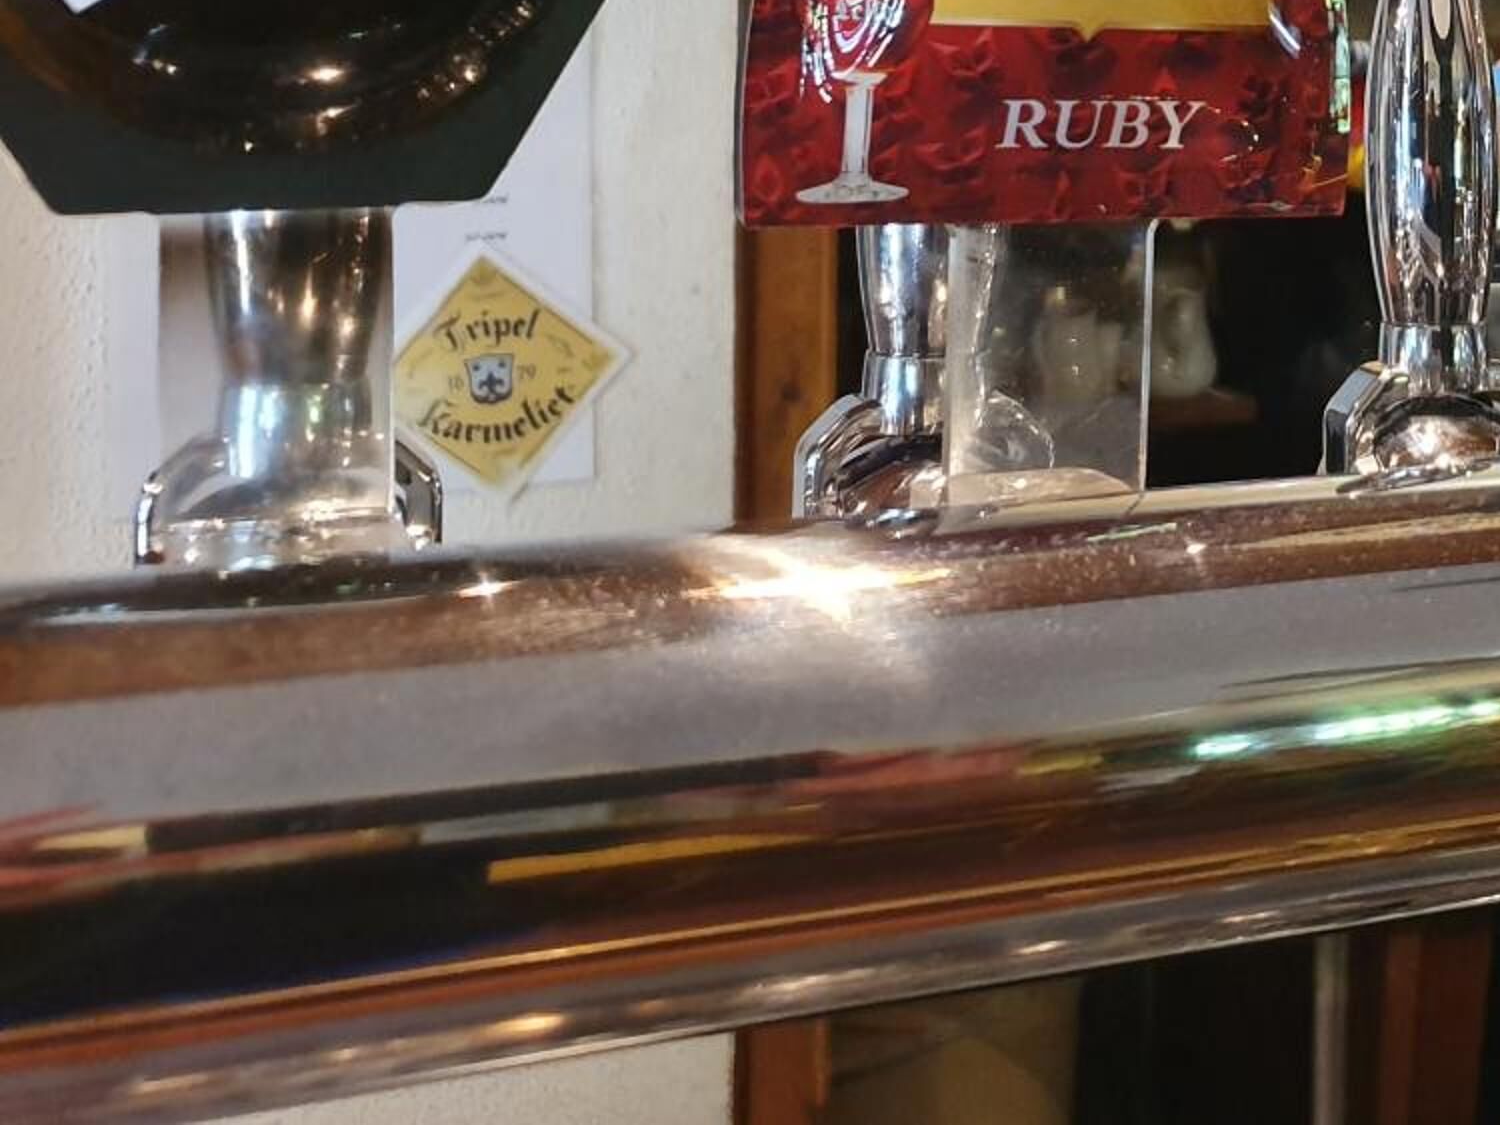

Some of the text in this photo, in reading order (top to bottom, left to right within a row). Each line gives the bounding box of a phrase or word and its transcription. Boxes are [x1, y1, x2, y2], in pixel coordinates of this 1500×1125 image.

[995, 97, 1207, 151] RUBY
[433, 308, 542, 351] Tripel
[418, 384, 575, 445] Karmeliet
